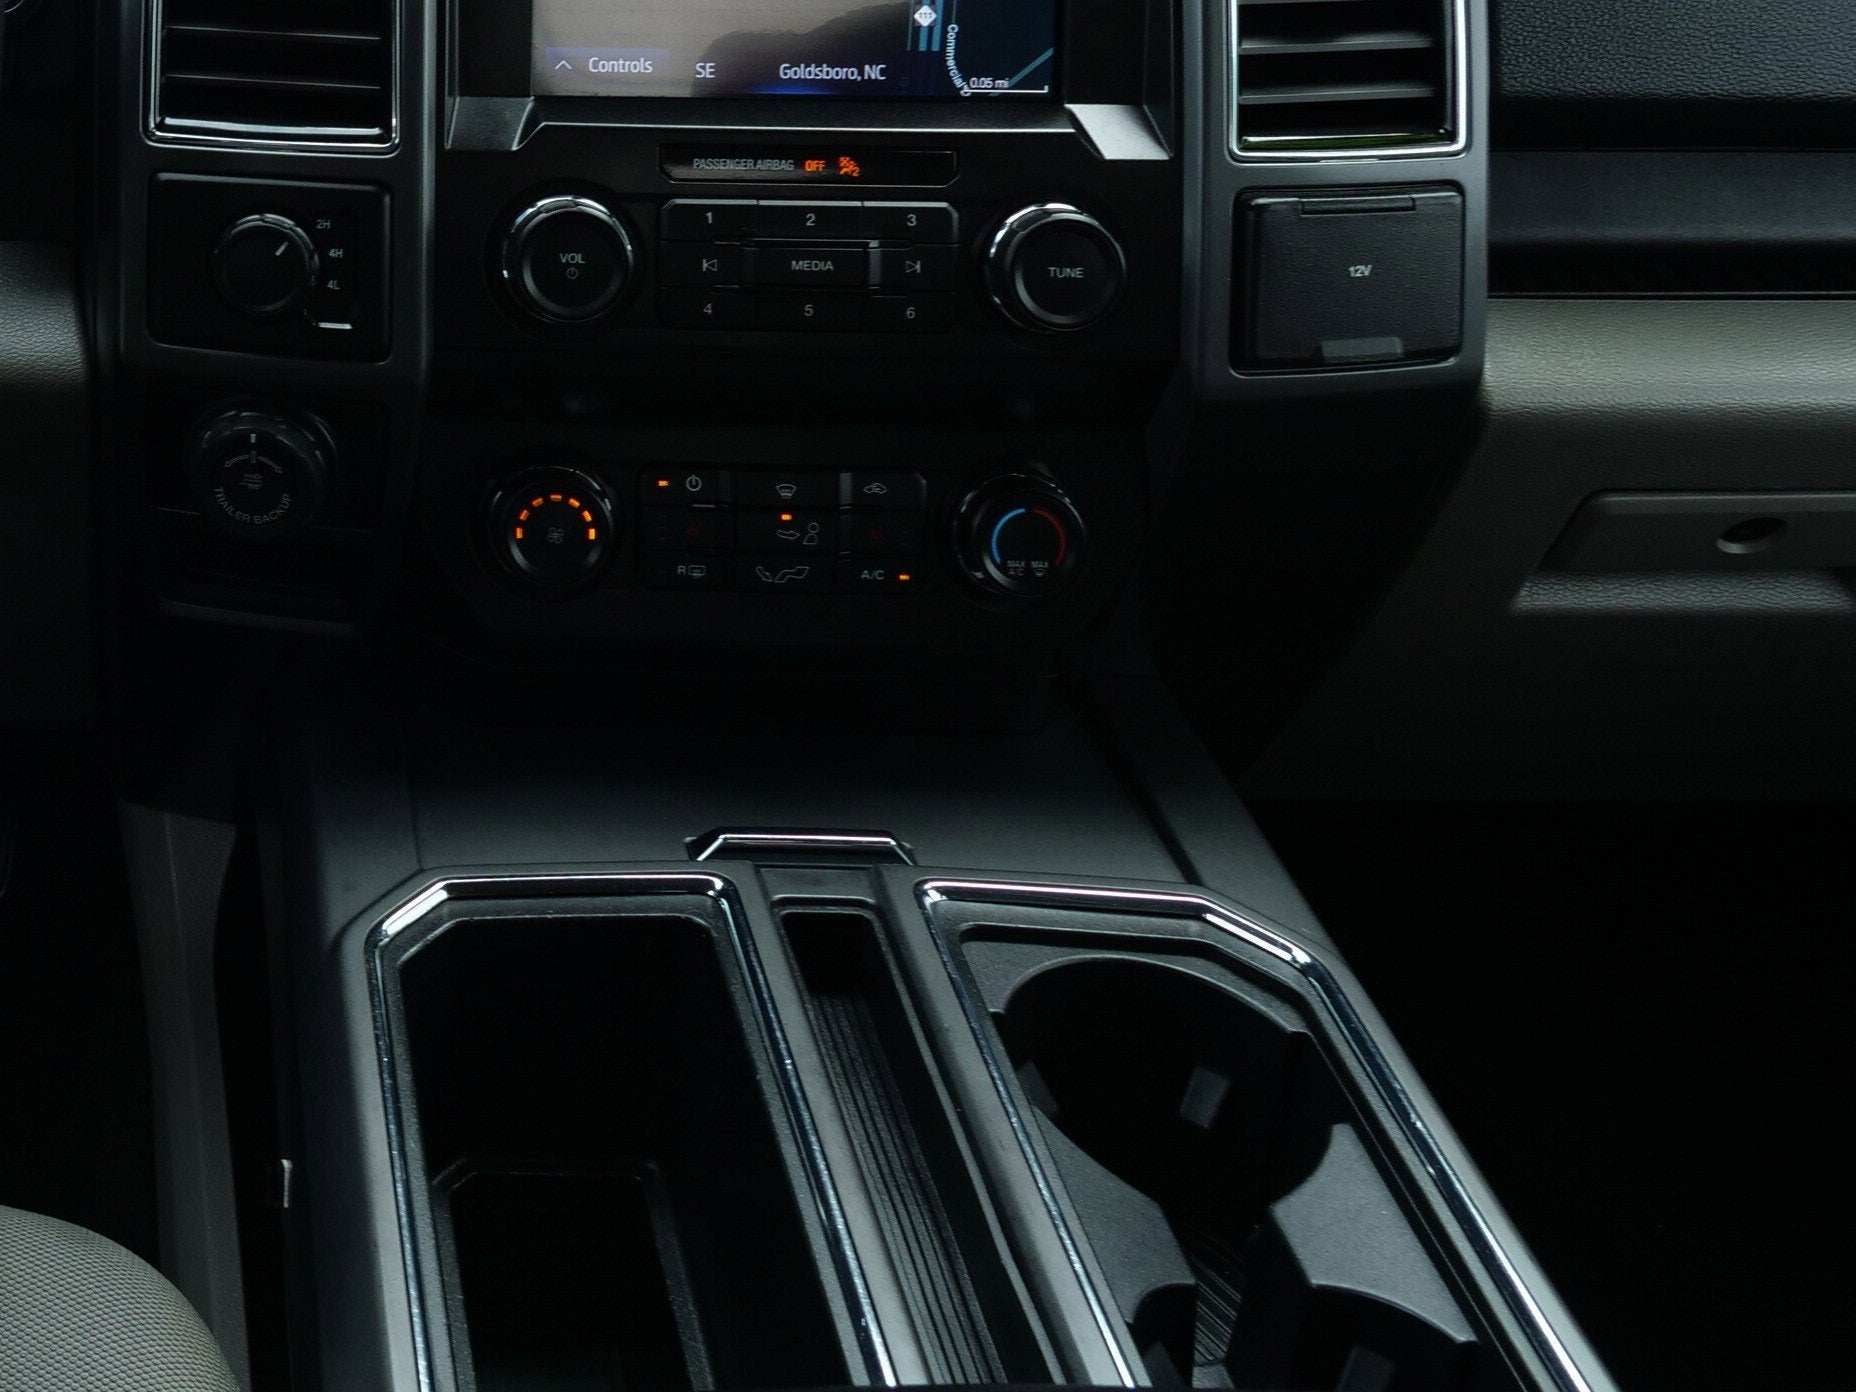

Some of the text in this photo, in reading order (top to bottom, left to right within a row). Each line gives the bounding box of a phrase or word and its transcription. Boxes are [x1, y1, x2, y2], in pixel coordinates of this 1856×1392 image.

[945, 23, 966, 89] Commercial
[588, 57, 654, 74] Controls
[695, 62, 717, 79] SE
[779, 63, 887, 82] Goldsboro, NC
[969, 77, 1010, 89] 0.05 mi
[693, 158, 827, 172] PASSENGER AIRBAG OFF
[315, 218, 332, 229] 2H
[704, 211, 714, 224] 1
[804, 213, 816, 227] 2
[906, 214, 918, 227] 3
[327, 248, 344, 258] 4H
[559, 252, 586, 264] VOL
[790, 259, 835, 272] MEDIA
[1047, 266, 1085, 278] TUNE
[1348, 263, 1373, 278] 12V
[326, 279, 341, 290] 4L
[702, 302, 714, 315] 4
[803, 303, 814, 317] 5
[905, 305, 917, 320] 6
[214, 486, 293, 525] TRAILER BACKUP
[860, 567, 886, 582] A/C
